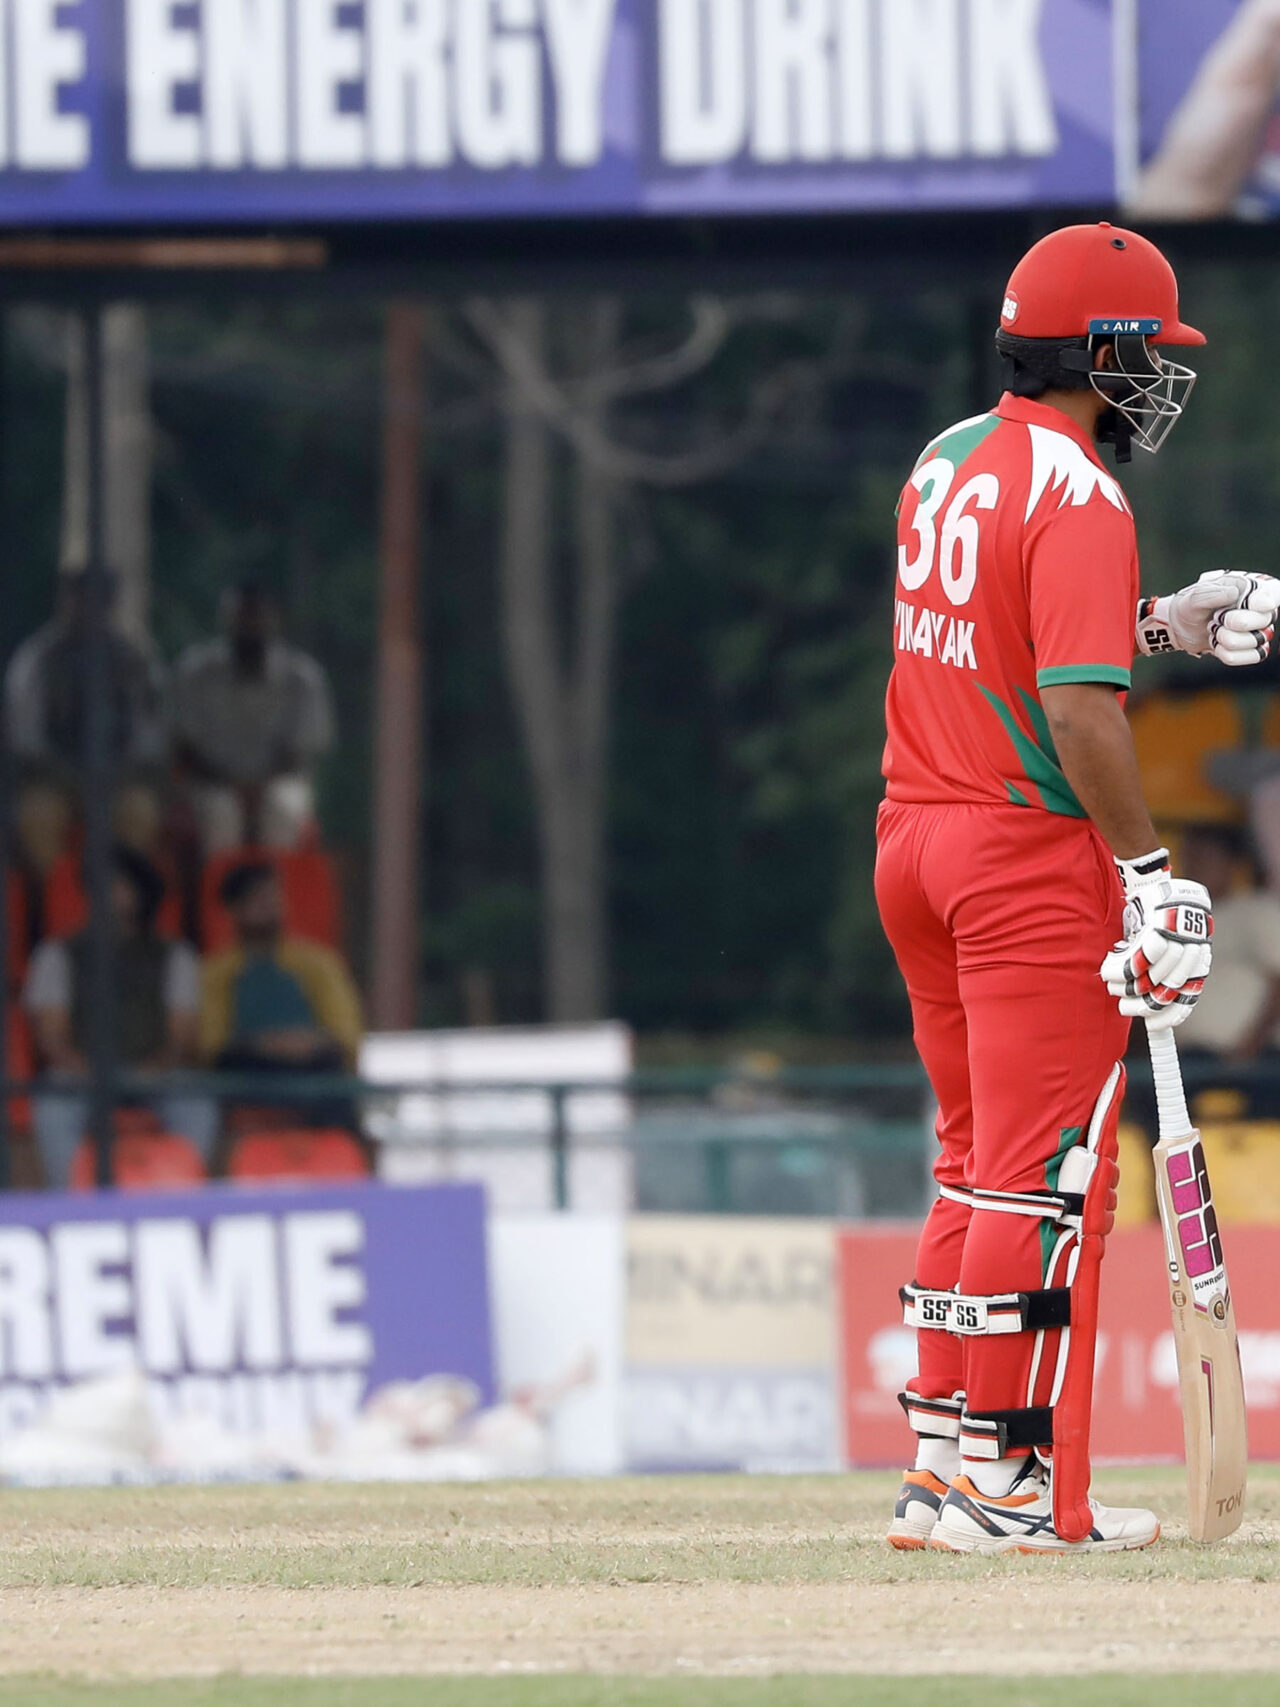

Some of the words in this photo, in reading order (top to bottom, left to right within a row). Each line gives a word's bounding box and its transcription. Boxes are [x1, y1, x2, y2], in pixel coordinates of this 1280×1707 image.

[126, 0, 613, 170] ENERGY
[659, 0, 1058, 166] DRINK
[1112, 321, 1140, 332] AIR
[897, 457, 999, 606] 36
[1184, 909, 1203, 936] SS
[922, 1298, 947, 1322] SS
[956, 1304, 978, 1328] SS
[1215, 1489, 1242, 1518] TON
